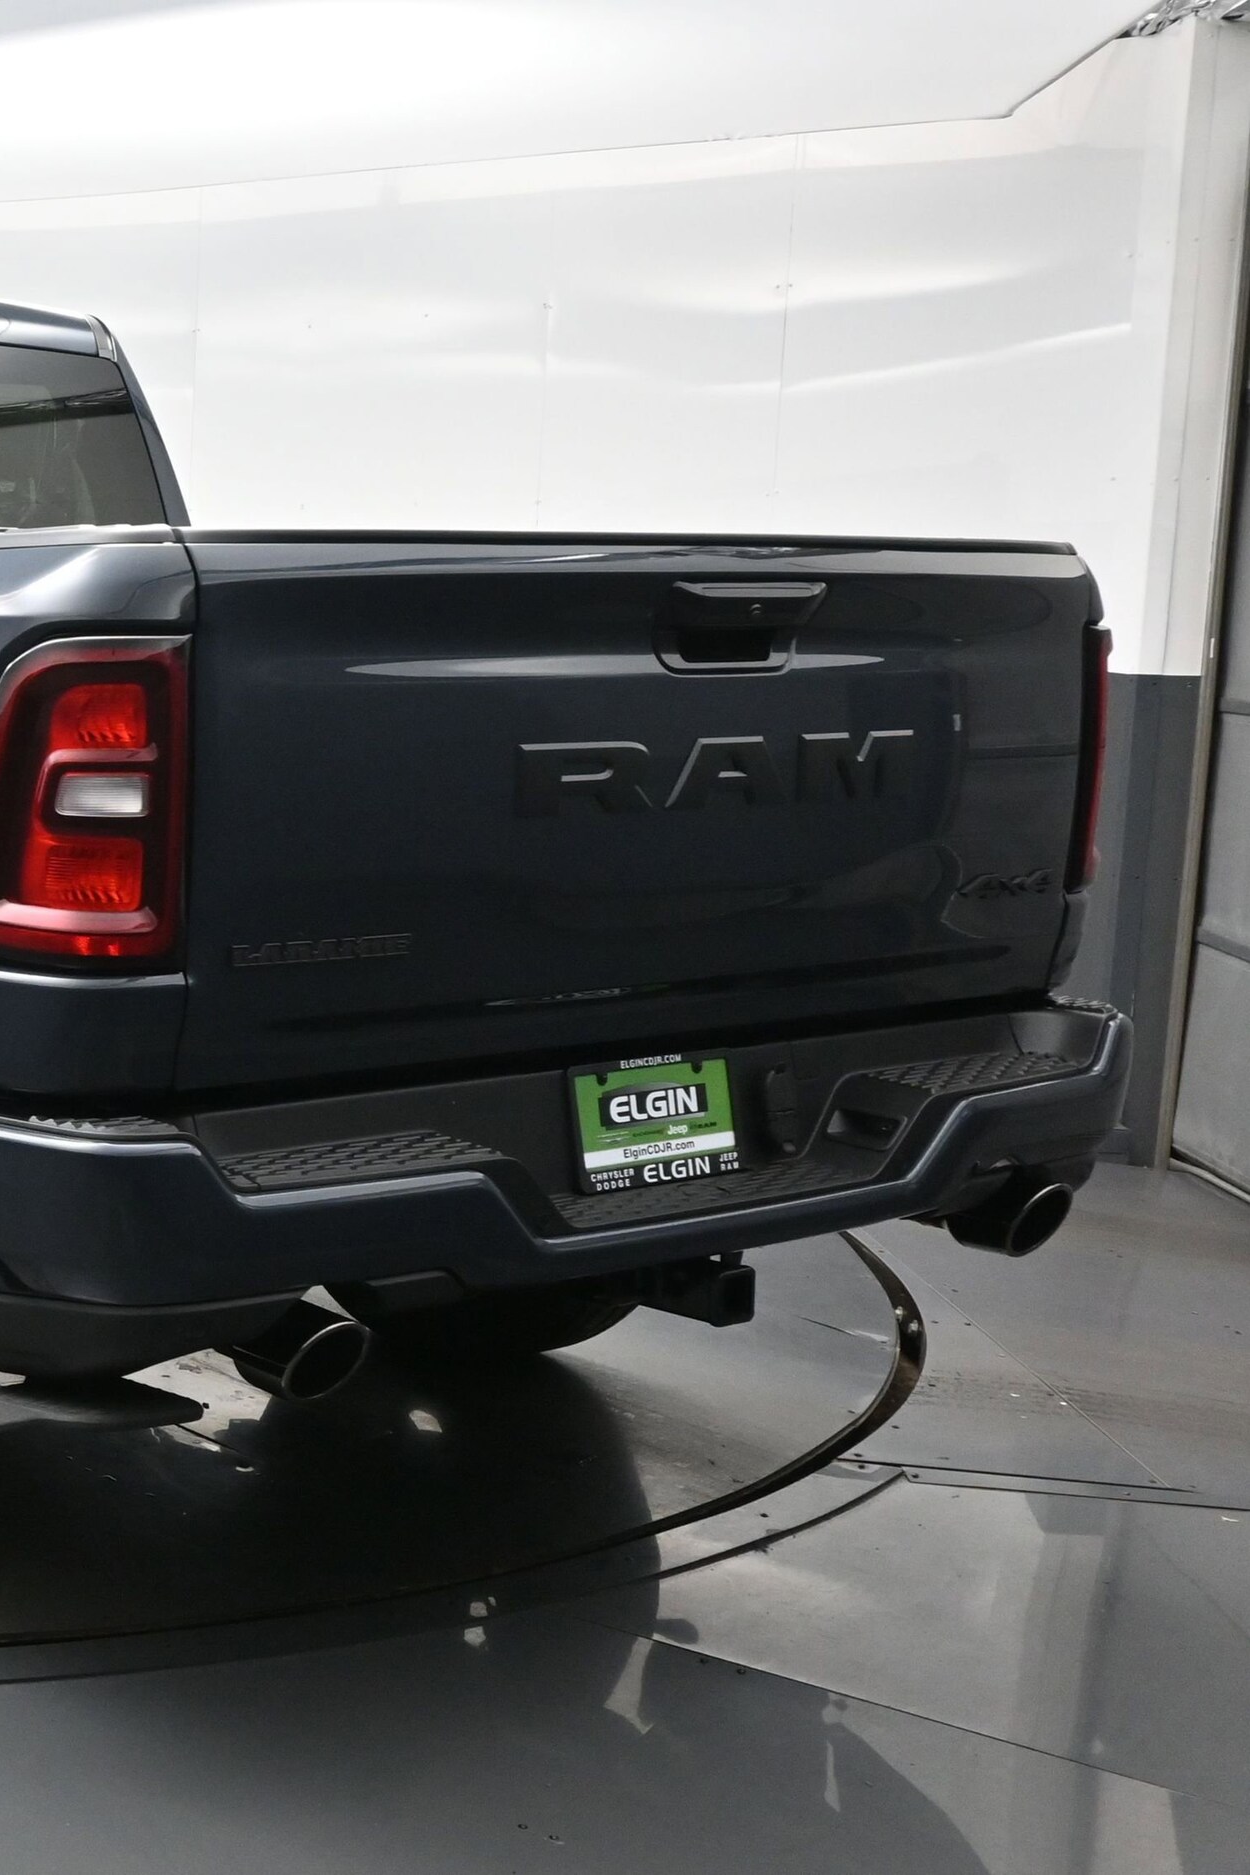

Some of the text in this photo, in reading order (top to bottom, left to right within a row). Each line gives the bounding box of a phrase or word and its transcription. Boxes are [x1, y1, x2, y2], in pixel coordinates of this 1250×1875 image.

[514, 729, 914, 816] RAM
[229, 933, 412, 968] LARAMIE
[620, 1053, 682, 1069] ELGINCDJR.COM
[609, 1086, 698, 1124] ELGIN
[667, 1124, 688, 1136] Jeep
[623, 1140, 695, 1160] ElginCDJR.com
[590, 1151, 738, 1183] CHRYSLER ELGIN JEEP
[596, 1161, 740, 1191] DODGE RAM
